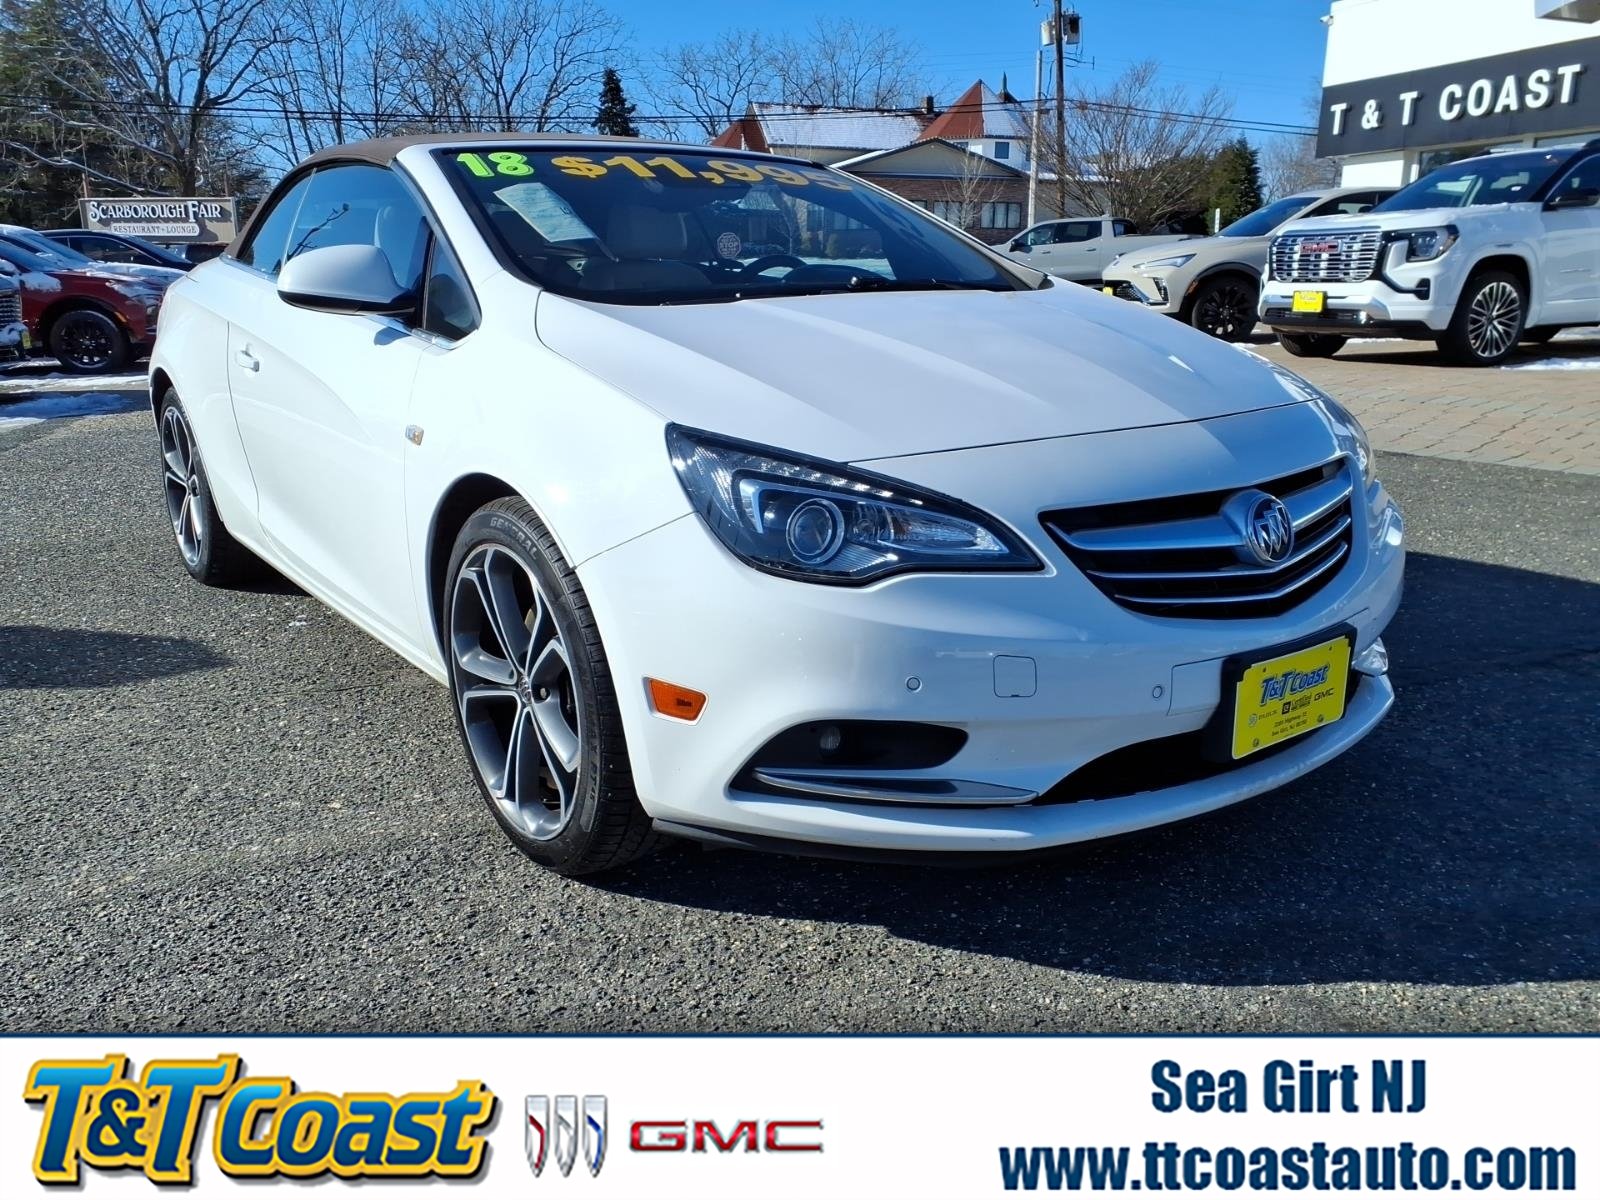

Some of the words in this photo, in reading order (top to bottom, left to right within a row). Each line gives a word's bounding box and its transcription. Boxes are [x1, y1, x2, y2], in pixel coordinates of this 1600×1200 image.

[1330, 103, 1347, 135] T
[1361, 99, 1380, 130] &
[1400, 91, 1418, 126] T
[1439, 64, 1582, 121] COAST
[457, 152, 535, 178] 18
[551, 156, 851, 190] $11,995
[89, 201, 186, 221] SCARBOROUGH
[187, 201, 221, 222] FAIR
[113, 225, 160, 234] RESTAURANT
[167, 225, 197, 234] LOUNGE
[490, 517, 538, 560] GENERAL
[1260, 671, 1294, 705] T&T
[1290, 664, 1330, 694] Coast
[1313, 687, 1335, 701] GMC
